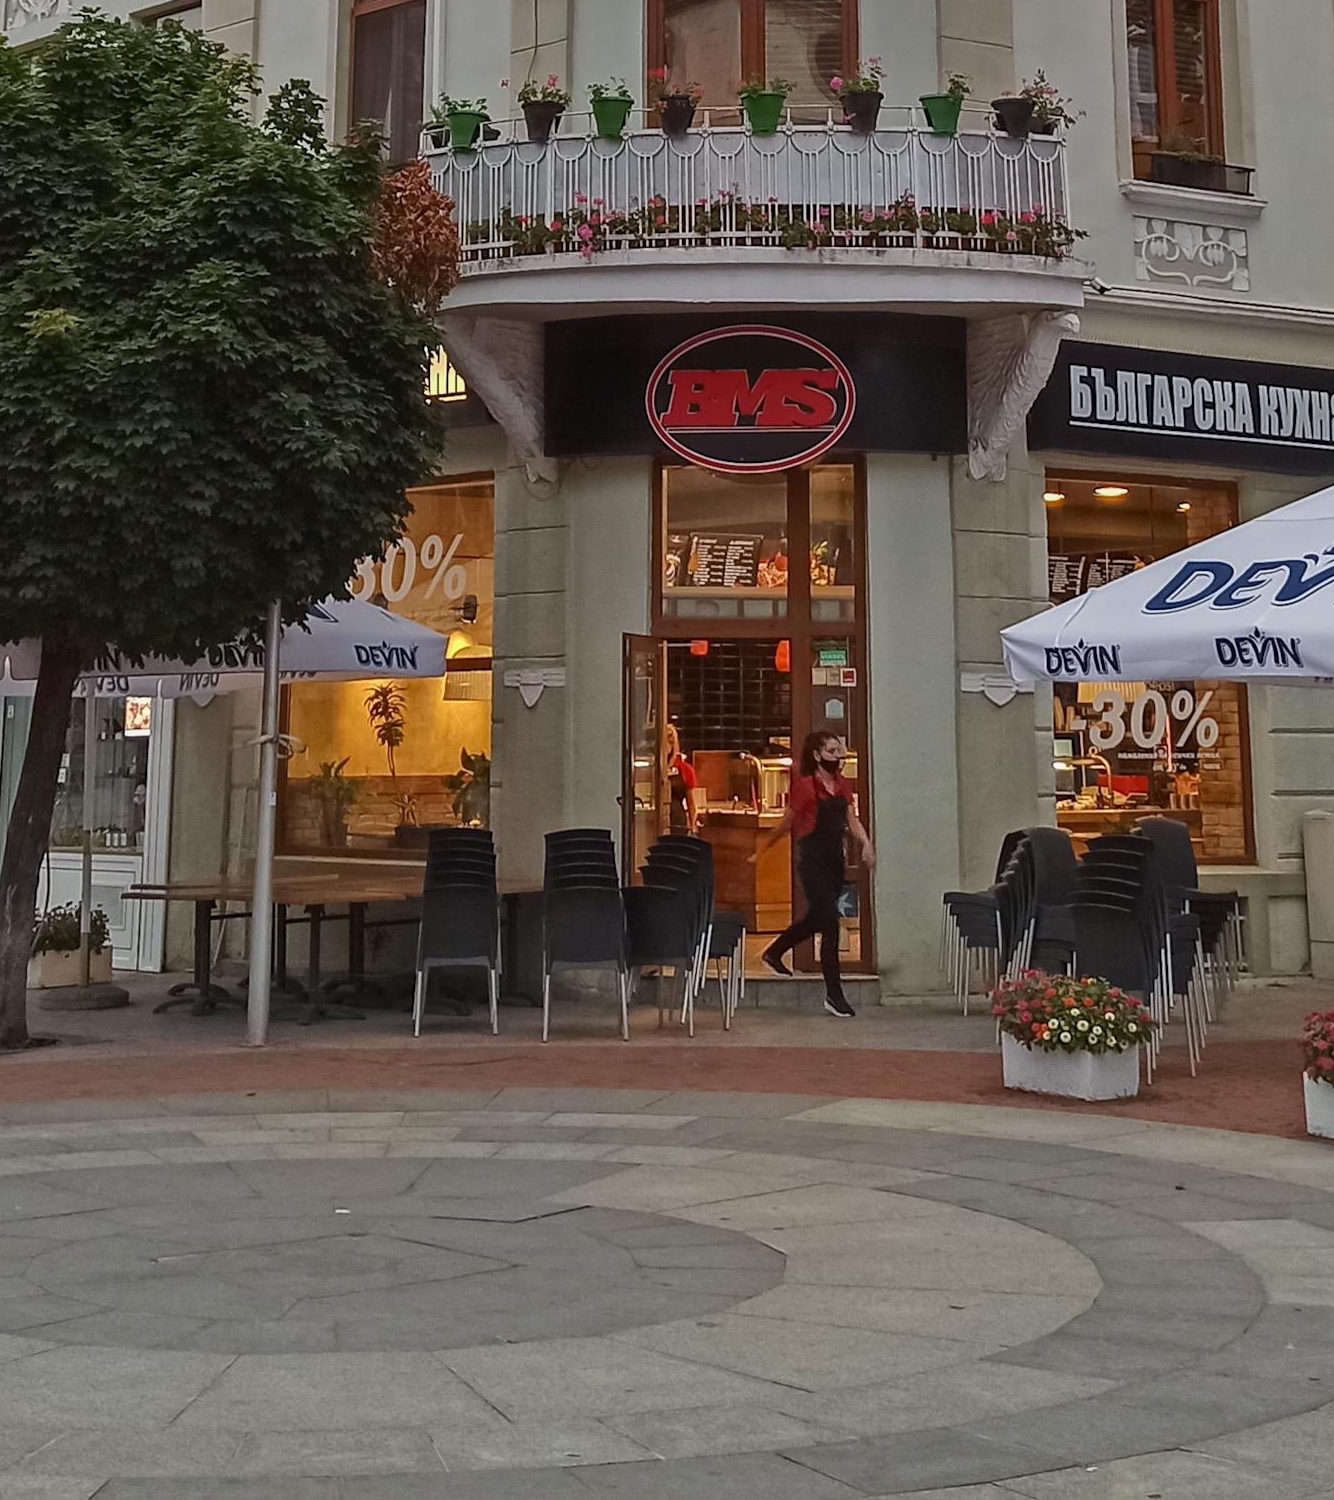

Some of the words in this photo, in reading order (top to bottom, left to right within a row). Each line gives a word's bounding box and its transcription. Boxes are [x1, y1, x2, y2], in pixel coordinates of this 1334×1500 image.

[661, 369, 840, 429] BMS
[1069, 365, 1255, 434] БЪЛГАРСКА
[355, 642, 418, 669] DEVIN
[1044, 641, 1121, 675] DEVIN
[1215, 631, 1305, 668] DEVIN
[1070, 689, 1219, 749] -30%
